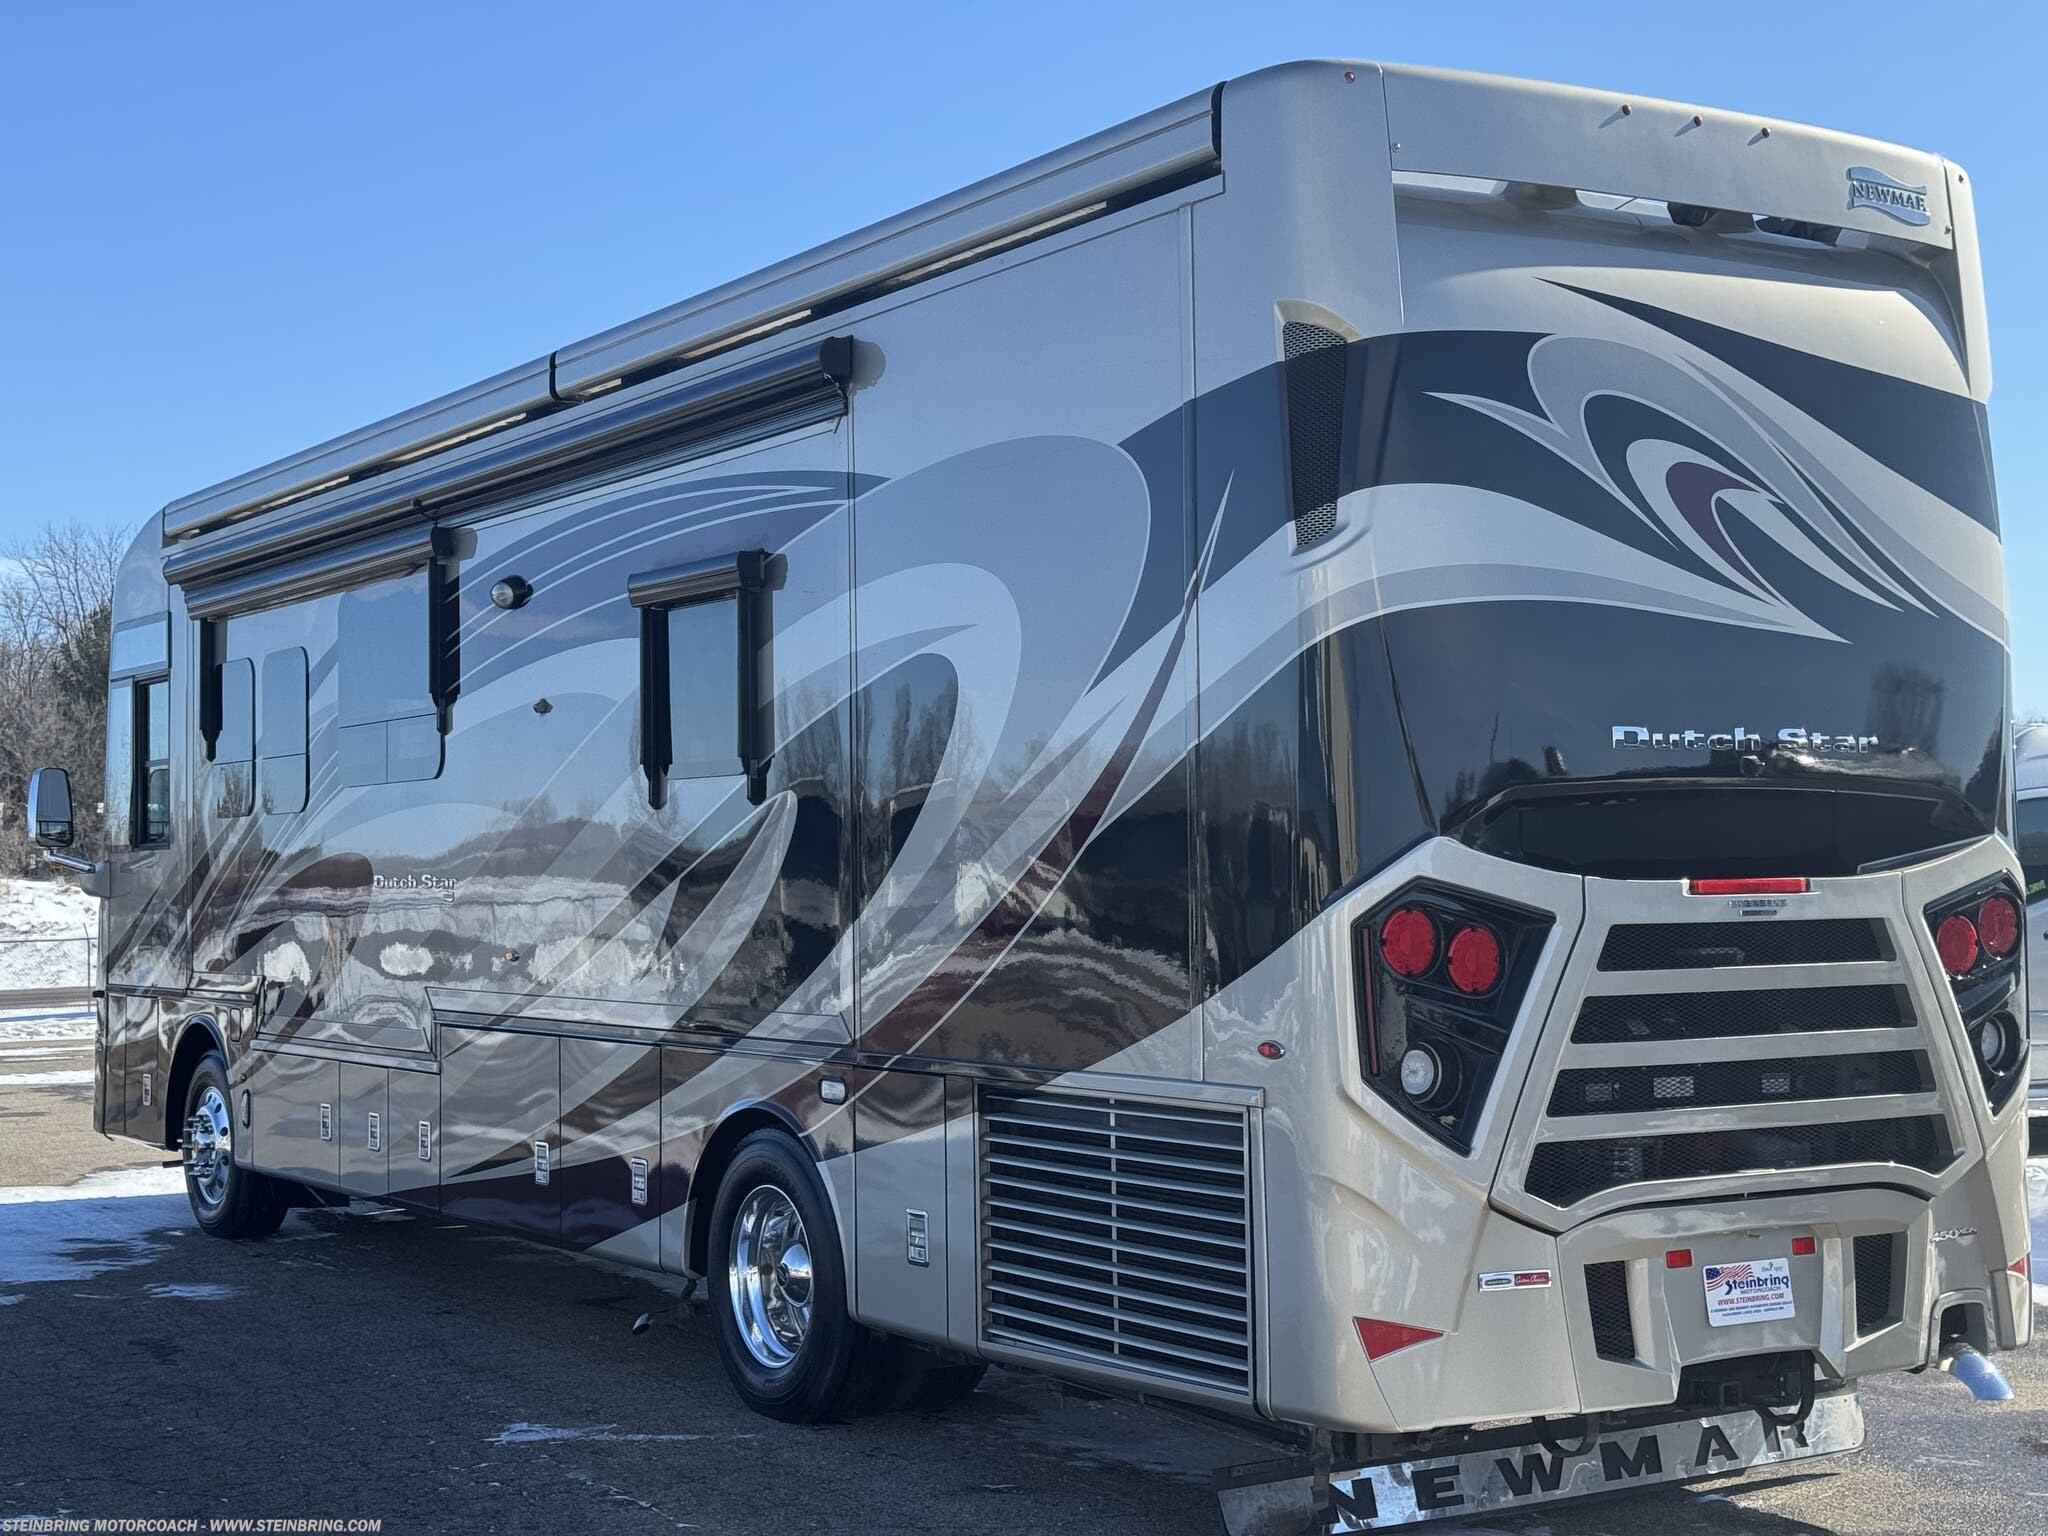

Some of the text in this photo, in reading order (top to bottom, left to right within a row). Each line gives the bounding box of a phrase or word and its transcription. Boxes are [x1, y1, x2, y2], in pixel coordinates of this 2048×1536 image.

[1849, 180, 1929, 213] NEWMAR
[1612, 725, 1879, 754] Dutch Star
[373, 874, 458, 890] Dutch Star
[1725, 1274, 1790, 1296] Steinbring
[1740, 1286, 1782, 1295] MOTORCOACH
[1717, 1292, 1785, 1306] WWW.STEINBRING.COM
